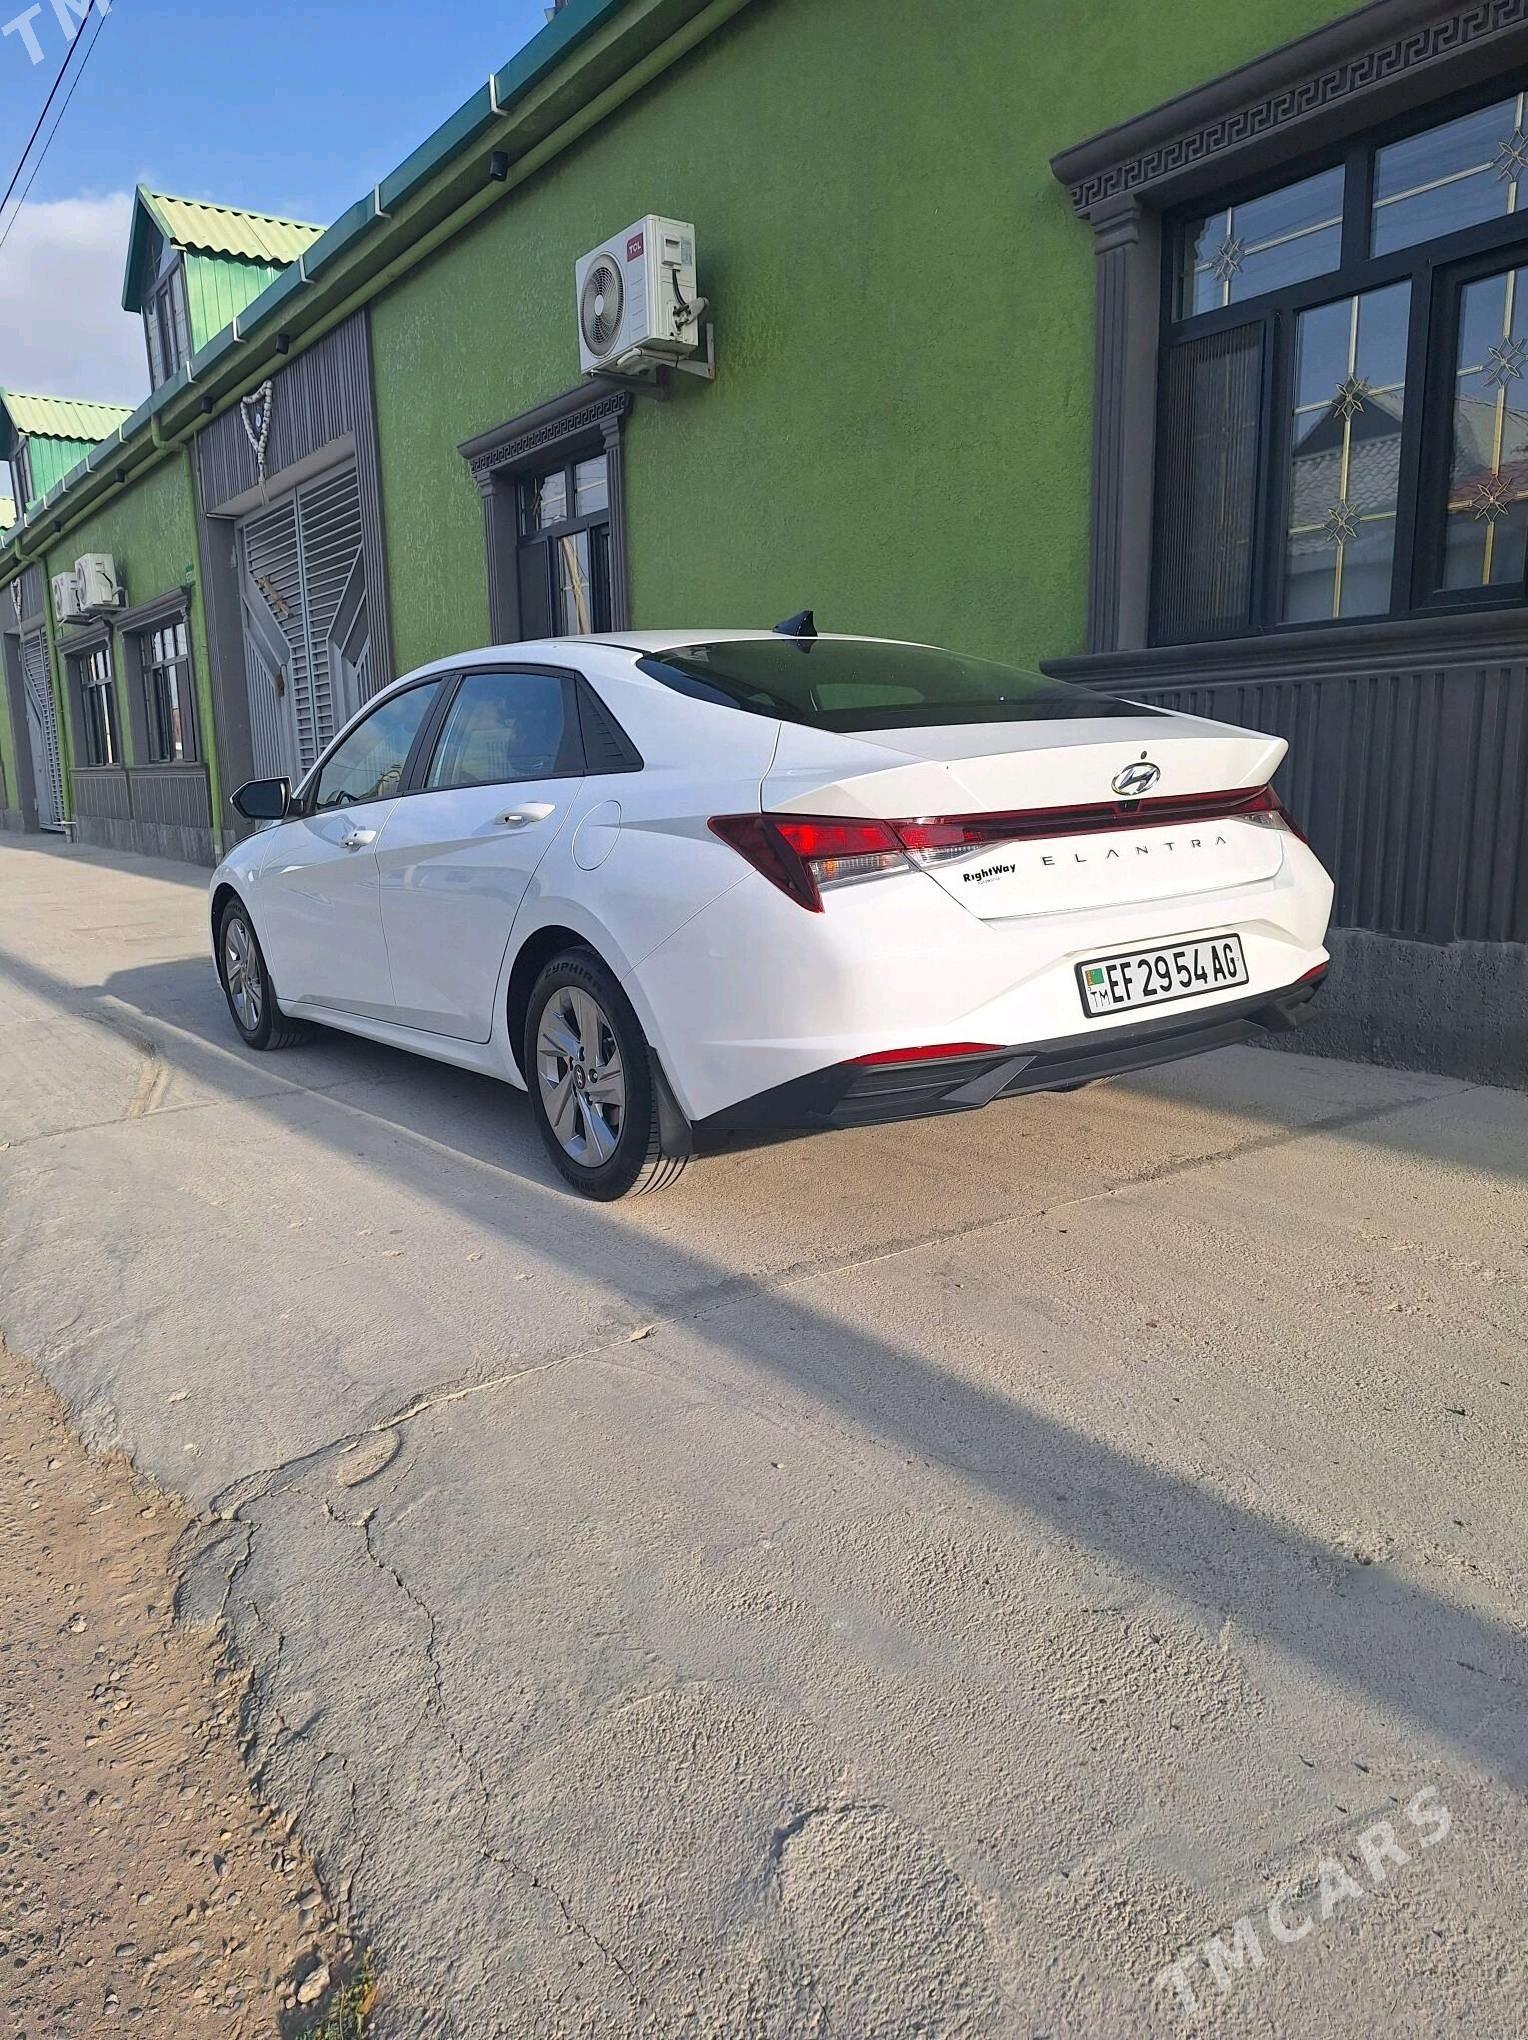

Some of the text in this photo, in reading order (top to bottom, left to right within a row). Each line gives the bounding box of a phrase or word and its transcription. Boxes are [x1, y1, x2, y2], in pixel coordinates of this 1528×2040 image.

[628, 240, 642, 254] TCL
[1042, 836, 1226, 866] ELANTRA
[963, 863, 1016, 882] RightWay
[1090, 989, 1110, 1008] TM
